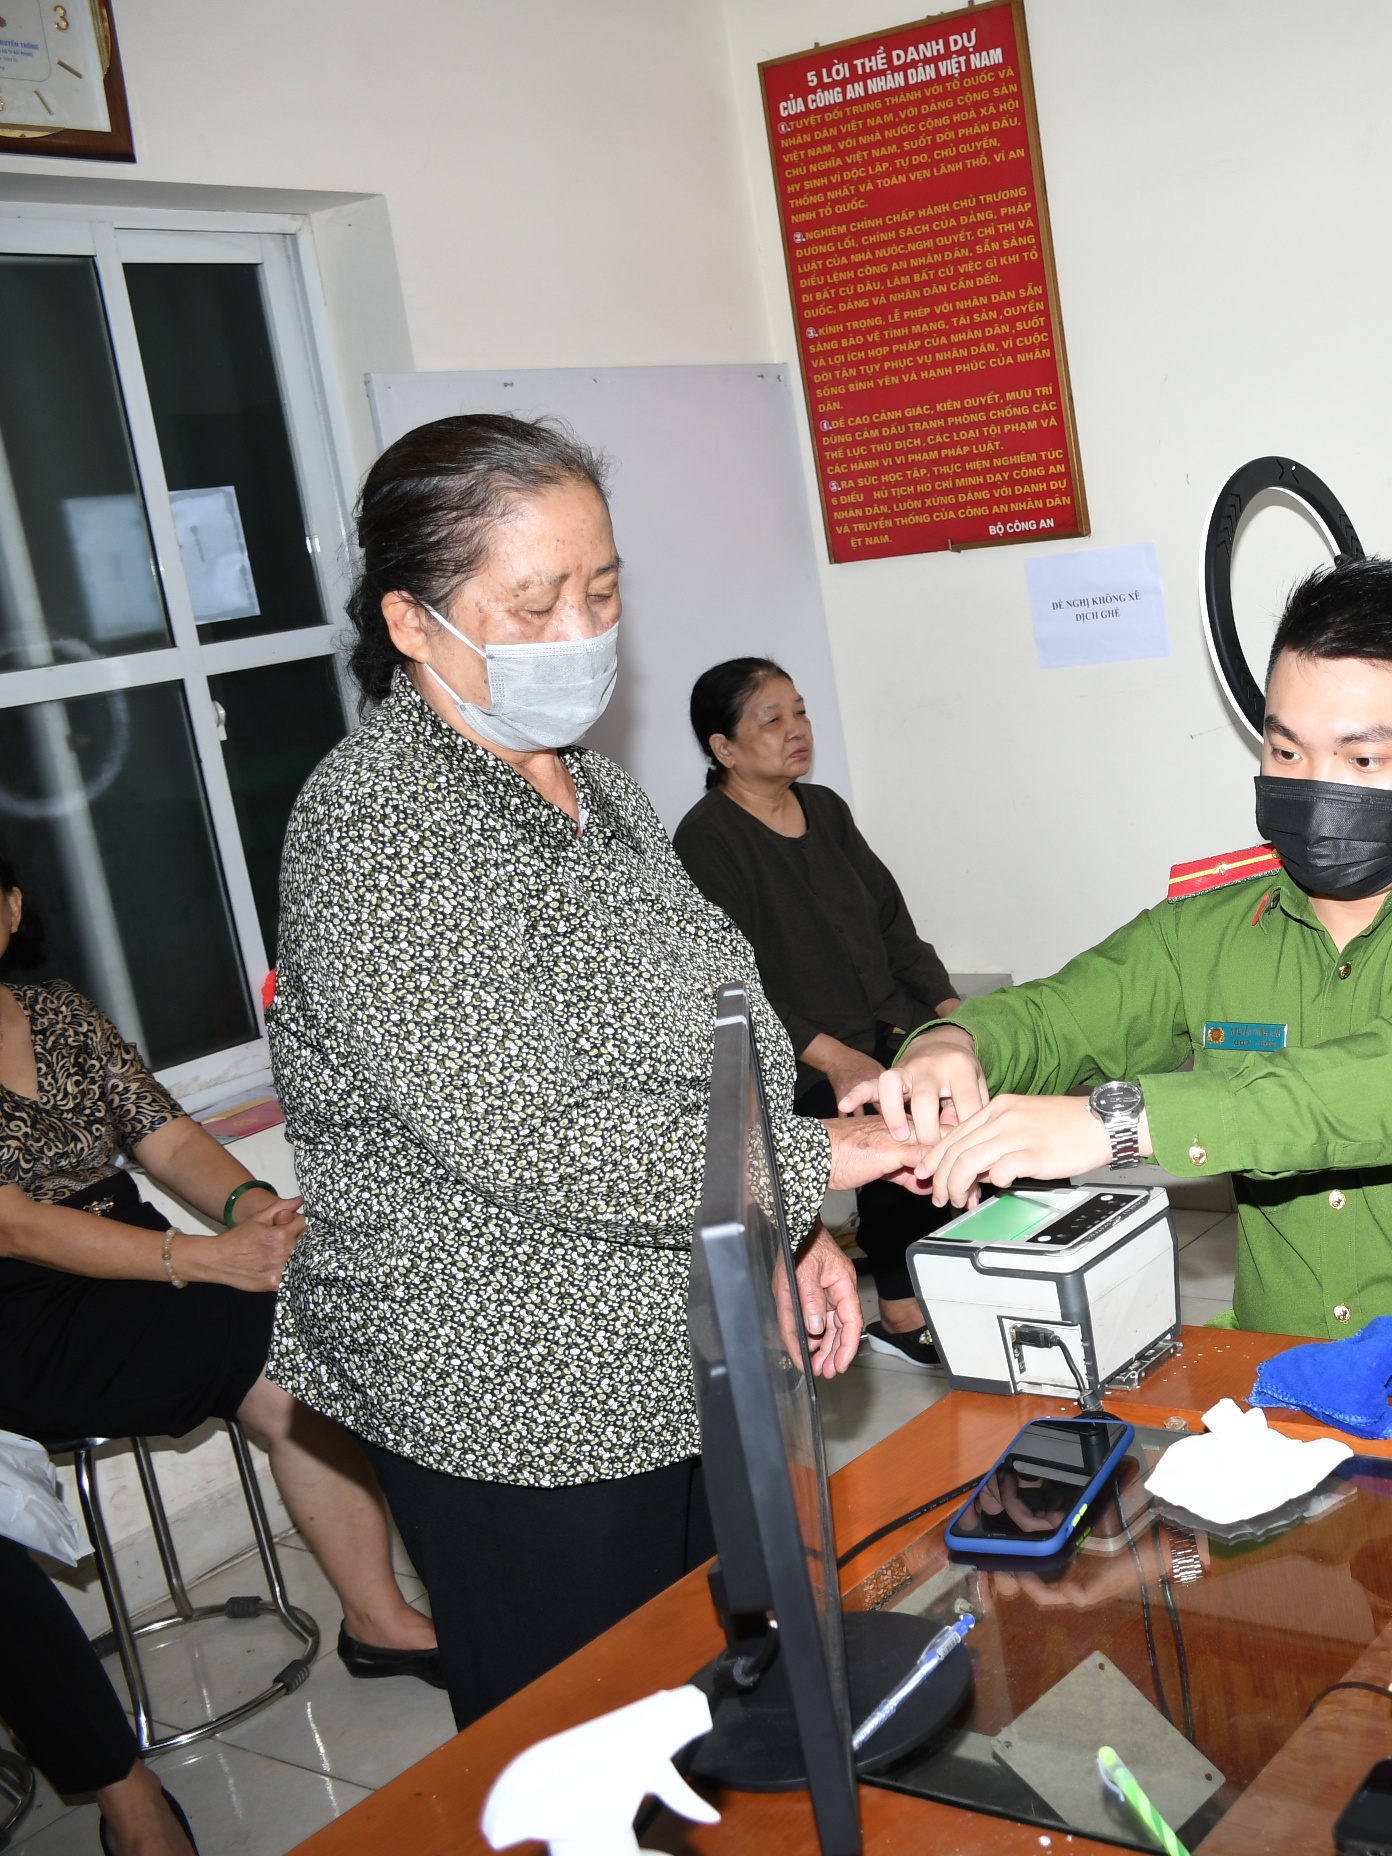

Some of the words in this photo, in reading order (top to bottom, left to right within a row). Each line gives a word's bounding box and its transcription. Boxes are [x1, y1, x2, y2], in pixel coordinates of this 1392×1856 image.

[52, 4, 70, 32] 3
[806, 70, 818, 87] 5
[821, 59, 851, 84] LỜI
[852, 45, 889, 75] THỀ
[891, 38, 945, 67] DANH
[948, 27, 977, 52] DỰ
[778, 93, 806, 118] CỦA
[806, 86, 844, 110] CÔNG
[845, 80, 866, 101] AN
[866, 70, 906, 95] NHÂN
[906, 62, 937, 85] DÂN
[937, 53, 967, 78] VIỆT
[969, 47, 1004, 70] NAM
[807, 143, 836, 158] NAM,
[871, 144, 901, 158] NAM,
[787, 182, 801, 193] HY
[803, 176, 828, 190] SINH
[911, 153, 931, 165] DO,
[791, 210, 817, 224] NINH
[891, 260, 908, 271] AN
[881, 457, 893, 467] VI
[894, 455, 906, 465] VI
[991, 503, 1009, 514] AN
[988, 521, 1005, 537] BỘ
[1005, 519, 1038, 533] CÔNG
[1039, 517, 1055, 529] AN
[864, 534, 893, 546] NAM.
[1091, 593, 1126, 607] KHÔNG
[1075, 611, 1099, 623] DỊCH
